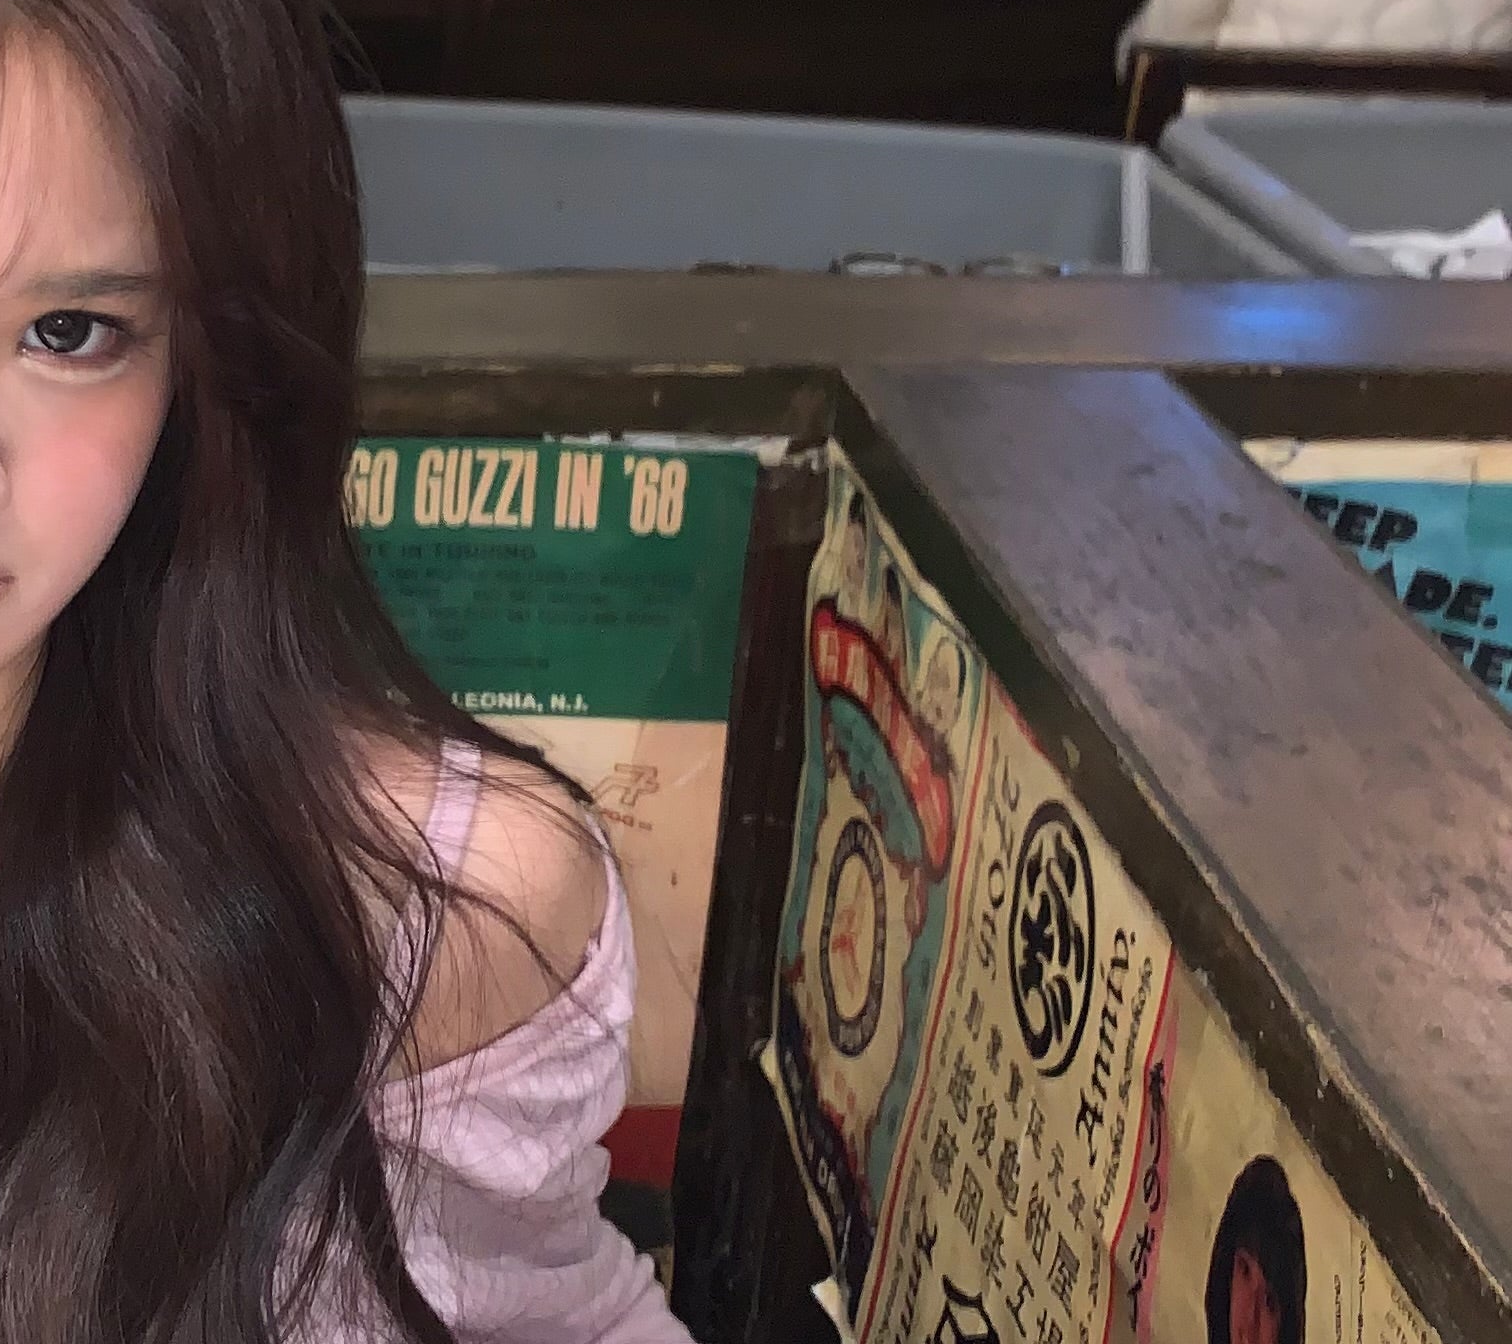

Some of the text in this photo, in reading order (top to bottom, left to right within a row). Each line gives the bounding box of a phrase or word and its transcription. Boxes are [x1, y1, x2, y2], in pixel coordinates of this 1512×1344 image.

[414, 446, 538, 531] GUZZI
[554, 450, 603, 532] IN
[623, 455, 688, 538] '68
[1076, 927, 1137, 1170] Anniv.
